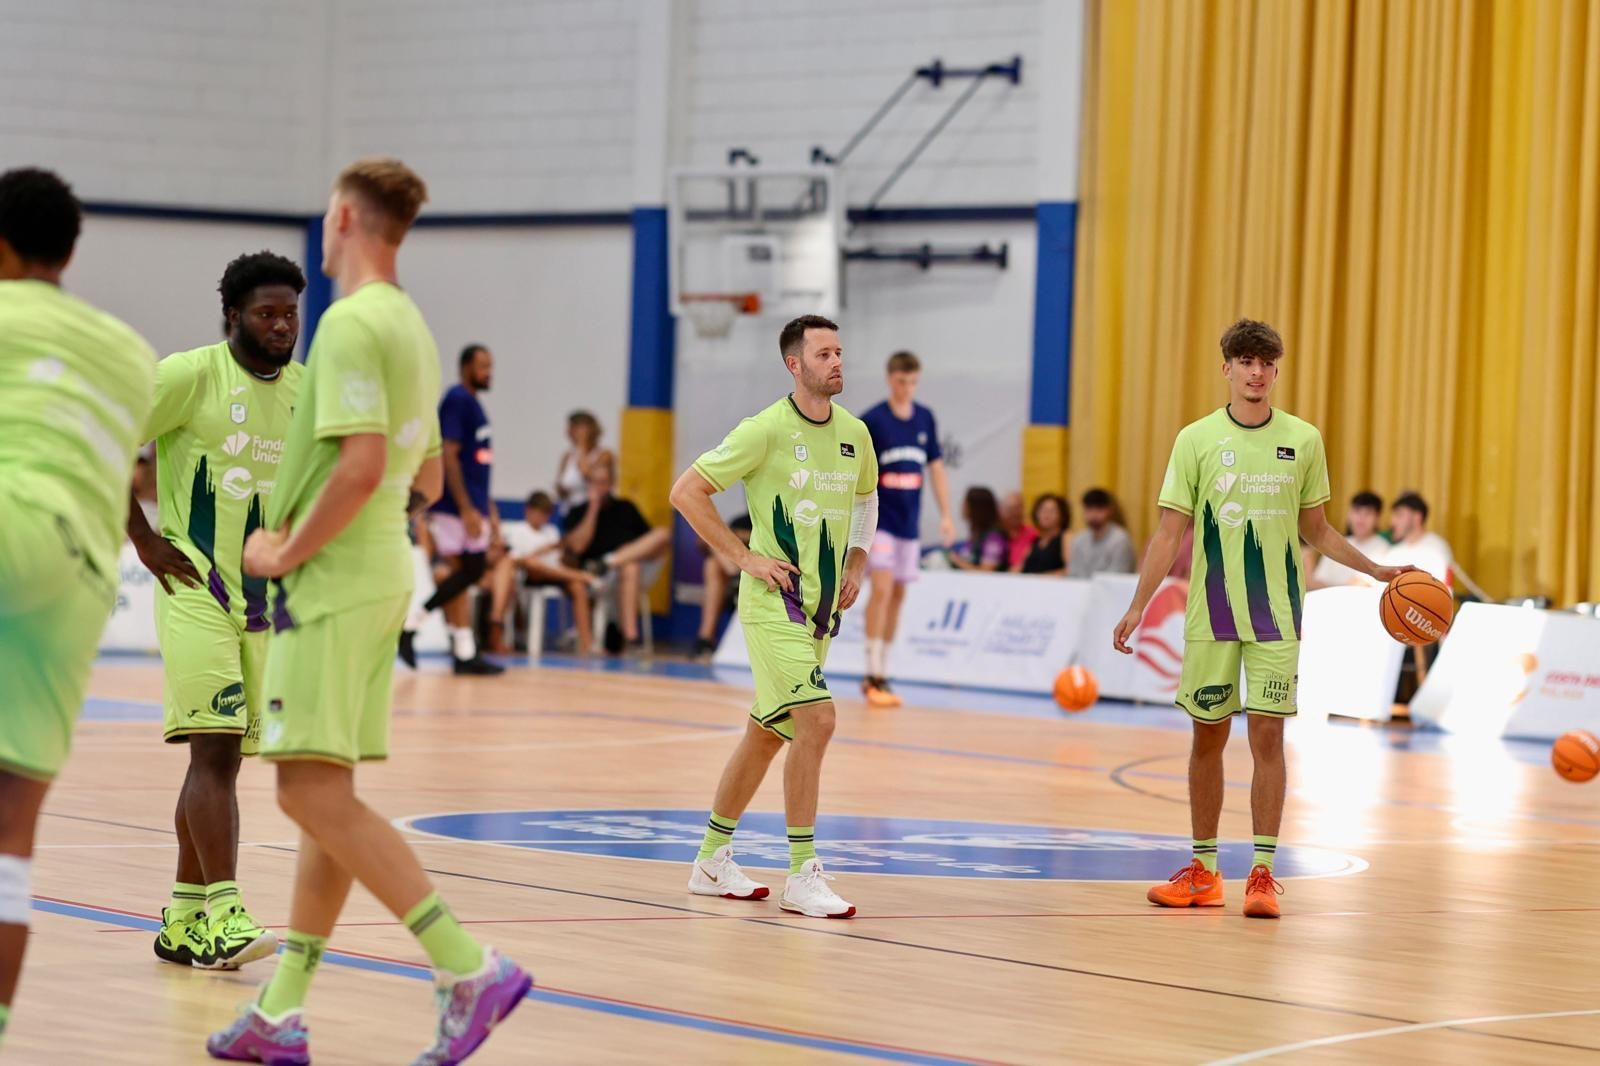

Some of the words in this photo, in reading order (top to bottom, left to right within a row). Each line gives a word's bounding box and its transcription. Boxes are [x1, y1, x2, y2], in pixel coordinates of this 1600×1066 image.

[1240, 472, 1296, 484] Fundación
[814, 480, 848, 495] Unicaja
[1240, 483, 1280, 496] Unicaja
[1405, 606, 1442, 640] Wilson
[1261, 685, 1288, 704] laga
